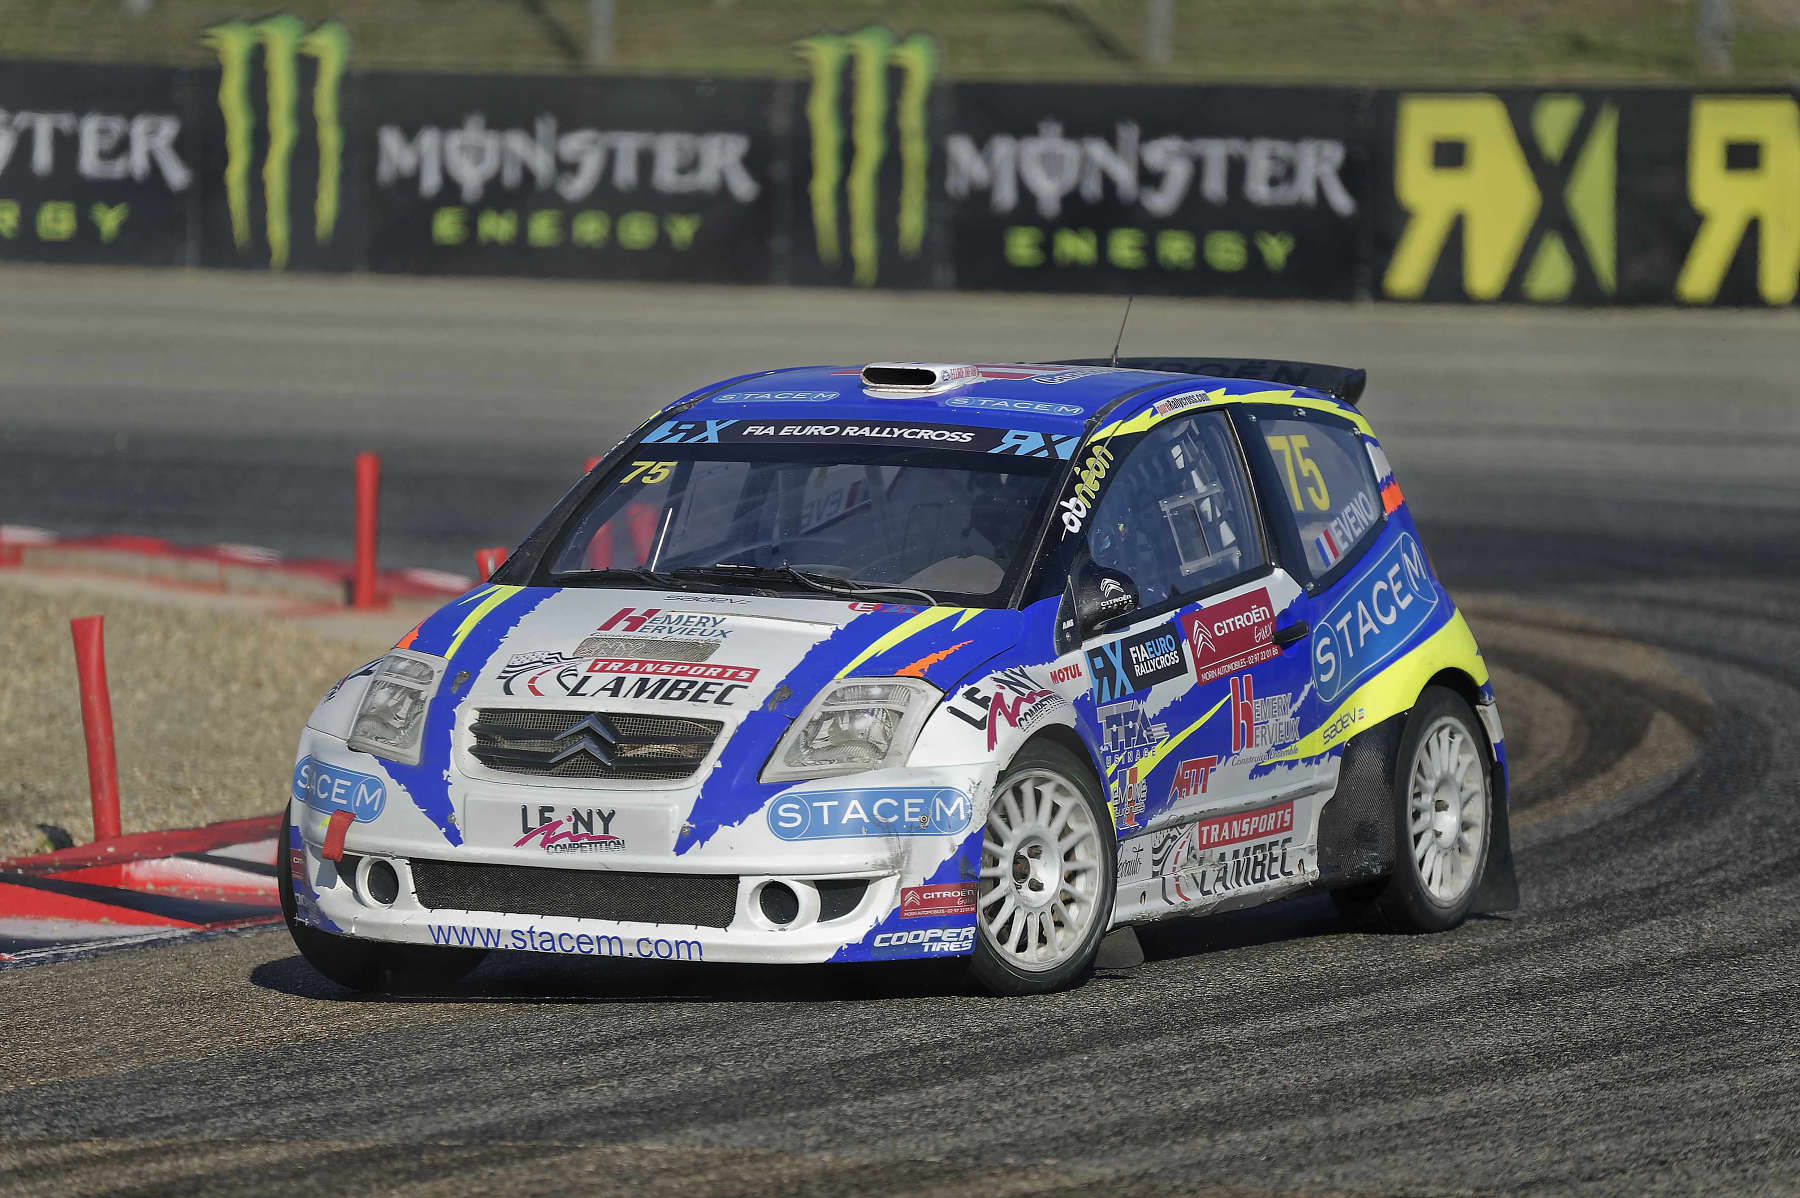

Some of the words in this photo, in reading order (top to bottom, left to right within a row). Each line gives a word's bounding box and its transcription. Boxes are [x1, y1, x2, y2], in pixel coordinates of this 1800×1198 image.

[377, 113, 759, 202] MONSTER
[946, 119, 1356, 218] MONSTER
[432, 206, 699, 250] ENERGY
[1005, 226, 1295, 272] ENERGY
[719, 391, 836, 401] STACEM
[950, 398, 1083, 415] STACEM
[742, 425, 776, 436] FIA
[779, 425, 839, 437] EURO
[842, 426, 976, 443] RALLYCROSS
[619, 460, 679, 485] 75
[1267, 434, 1330, 512] 75
[1330, 491, 1375, 551] EVENO
[1316, 542, 1427, 682] STACEM
[592, 660, 754, 681] TRANSPORTS
[1050, 664, 1082, 684] MOTUL
[1134, 650, 1179, 677] RALLYCROSS
[567, 675, 749, 706] LAMBEC
[777, 797, 966, 828] STACEM
[1201, 807, 1292, 844] TRANSPORTS
[546, 839, 626, 854] COMPETITION
[1200, 837, 1294, 897] LAMBEC
[428, 924, 704, 961] www.stacem.com
[873, 926, 976, 947] COOPER
[922, 940, 973, 952] TIRES
